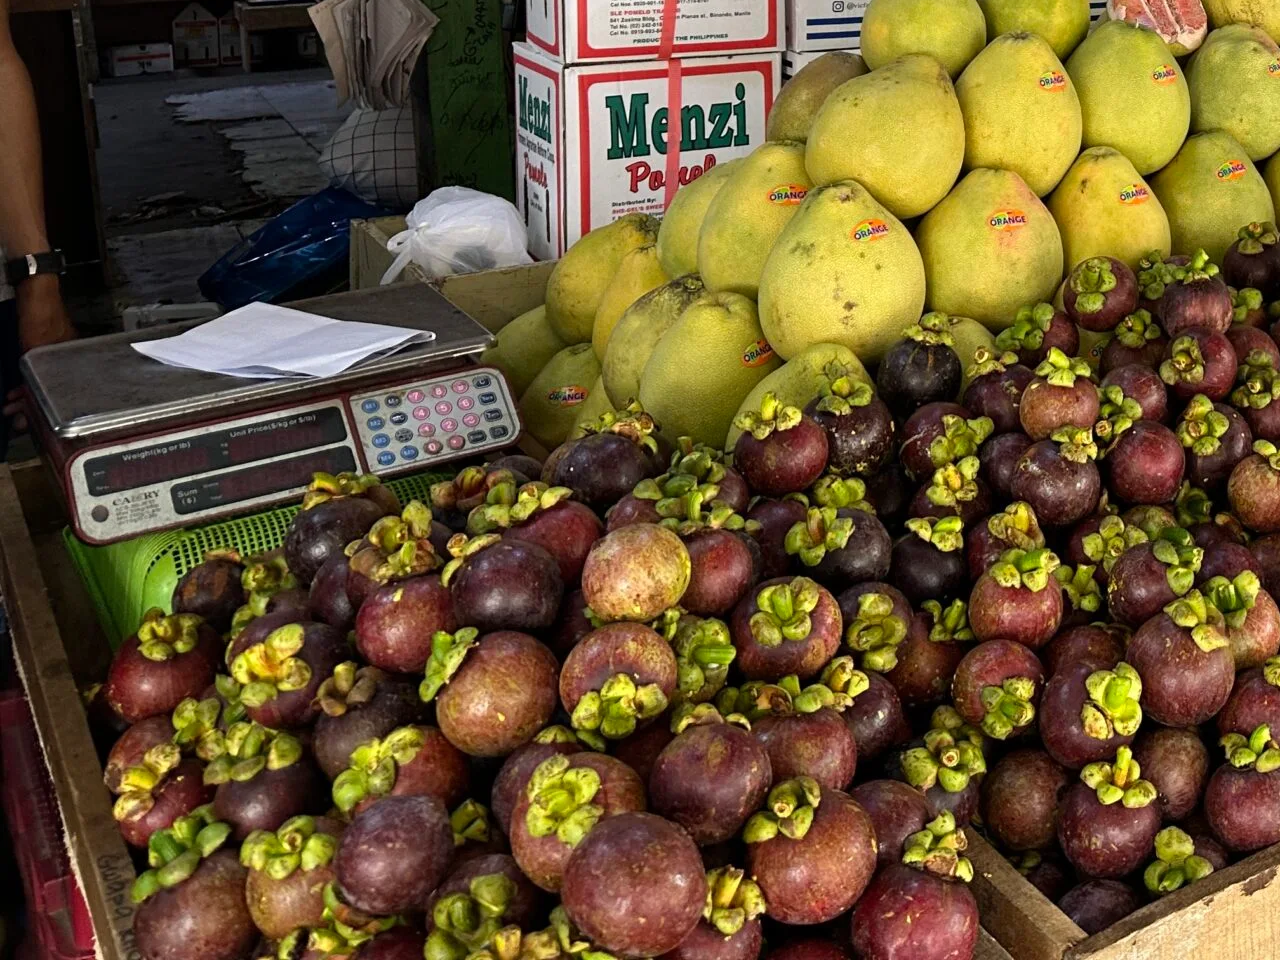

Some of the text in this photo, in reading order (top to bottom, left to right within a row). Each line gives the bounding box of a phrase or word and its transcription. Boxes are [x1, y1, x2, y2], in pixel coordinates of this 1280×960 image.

[689, 33, 729, 41] PHILIPPINES
[1040, 75, 1066, 87] ORANGE
[1152, 69, 1177, 80] ORANGE
[518, 73, 552, 145] Menzi
[605, 82, 749, 160] Menzi
[523, 151, 548, 190] Pomelo
[1217, 163, 1246, 179] ORANGE
[1120, 189, 1149, 202] ORANGE
[990, 214, 1027, 228] ORANGE
[853, 223, 888, 241] ORANGE
[549, 391, 585, 402] ORANGE
[229, 428, 246, 439] Unit
[289, 419, 298, 428] or
[121, 446, 167, 461] Weight(kg
[179, 441, 191, 451] lb)
[176, 488, 198, 499] Sum
[180, 496, 197, 506] ($)
